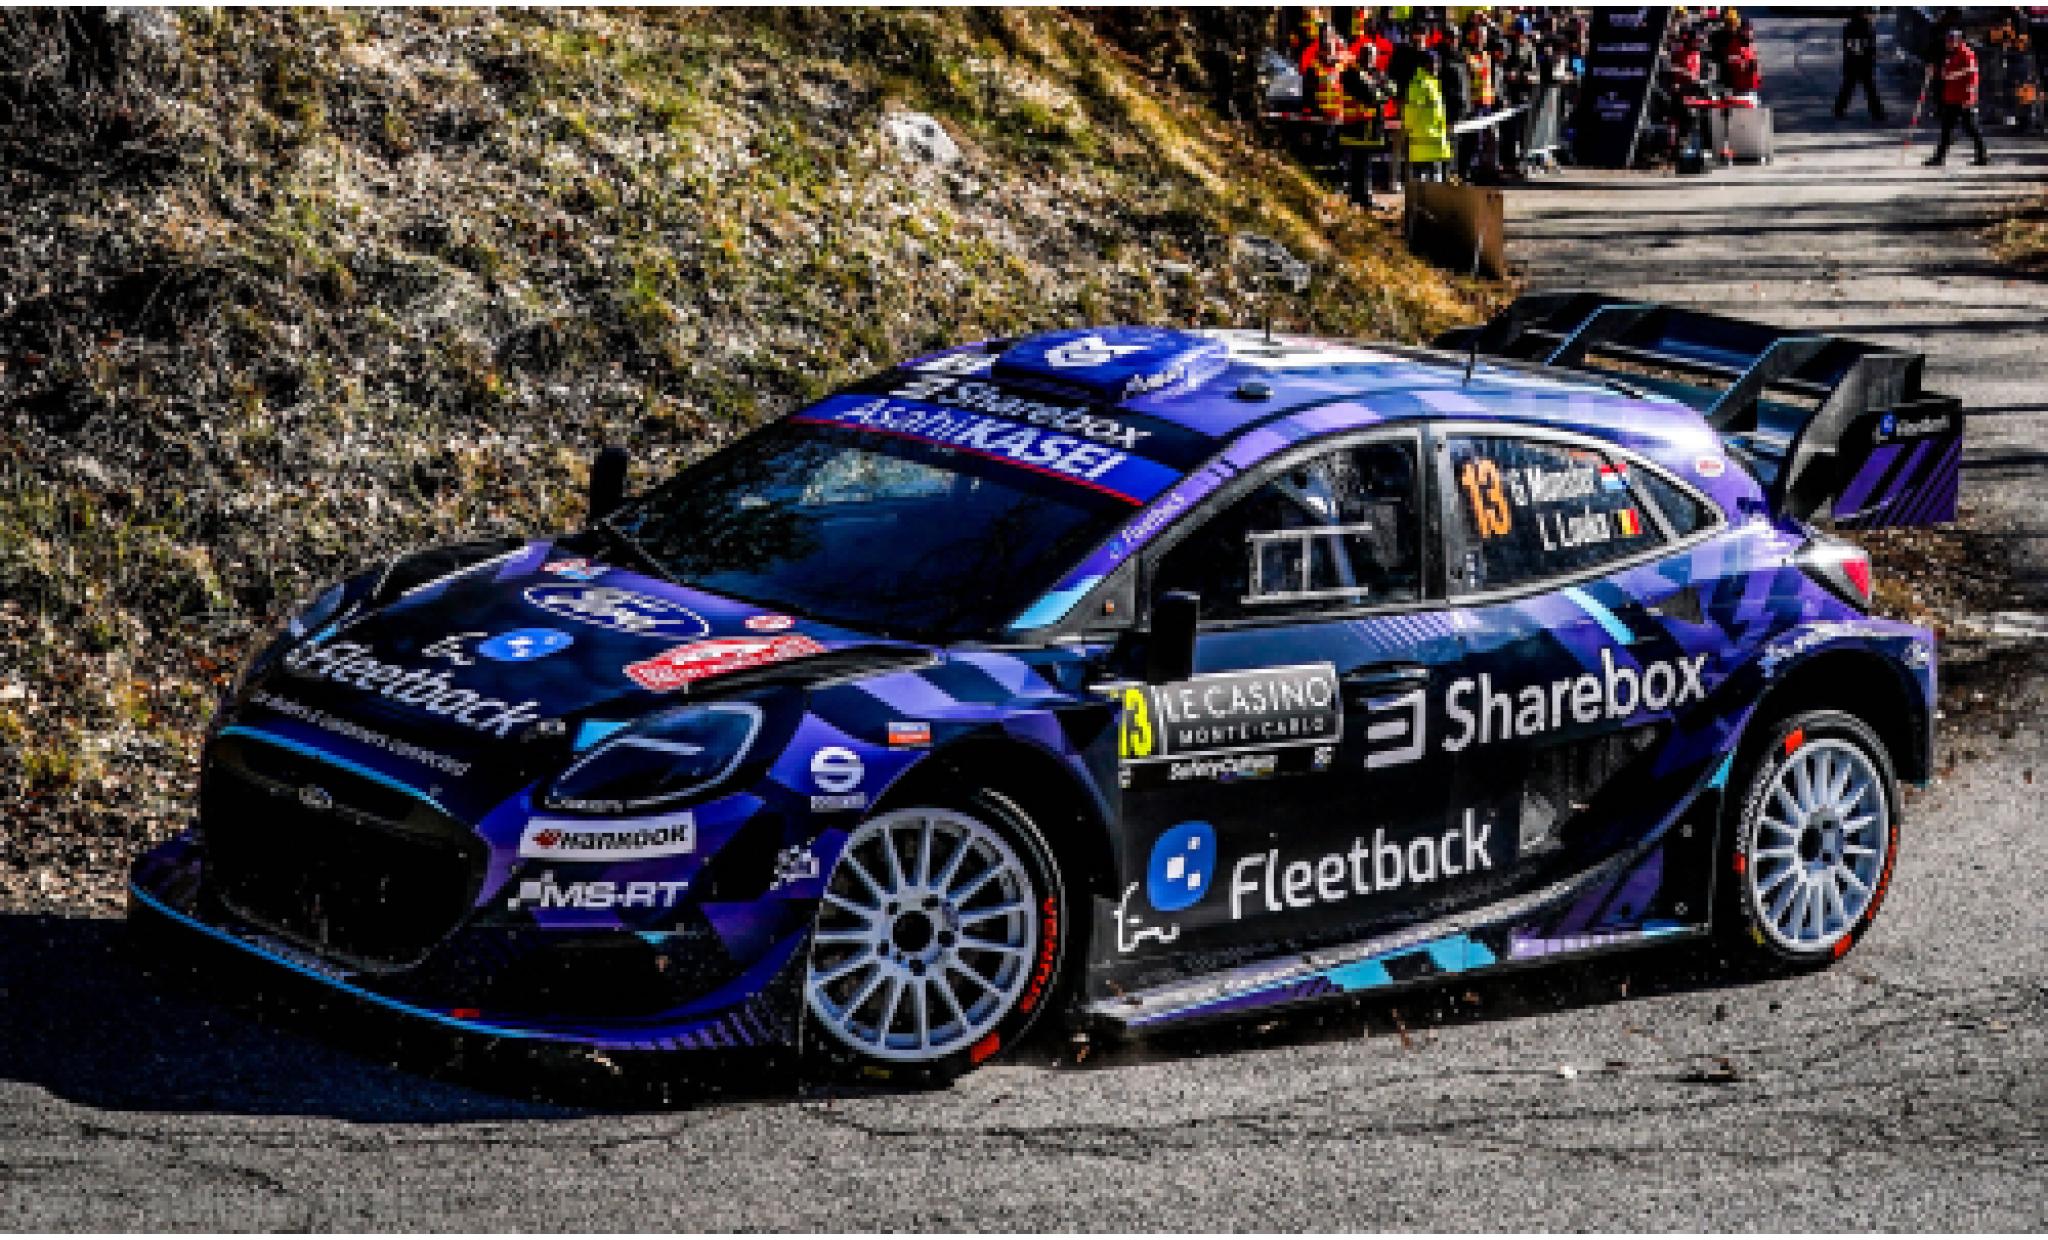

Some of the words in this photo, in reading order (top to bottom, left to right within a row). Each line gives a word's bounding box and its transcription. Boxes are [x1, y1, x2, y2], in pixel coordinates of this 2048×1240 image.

[938, 380, 1152, 449] Sharebox
[1461, 458, 1513, 539] 13
[1202, 676, 1333, 722] CASINO
[1441, 650, 1708, 752] Sharebox
[1228, 808, 1494, 920] Fleetback
